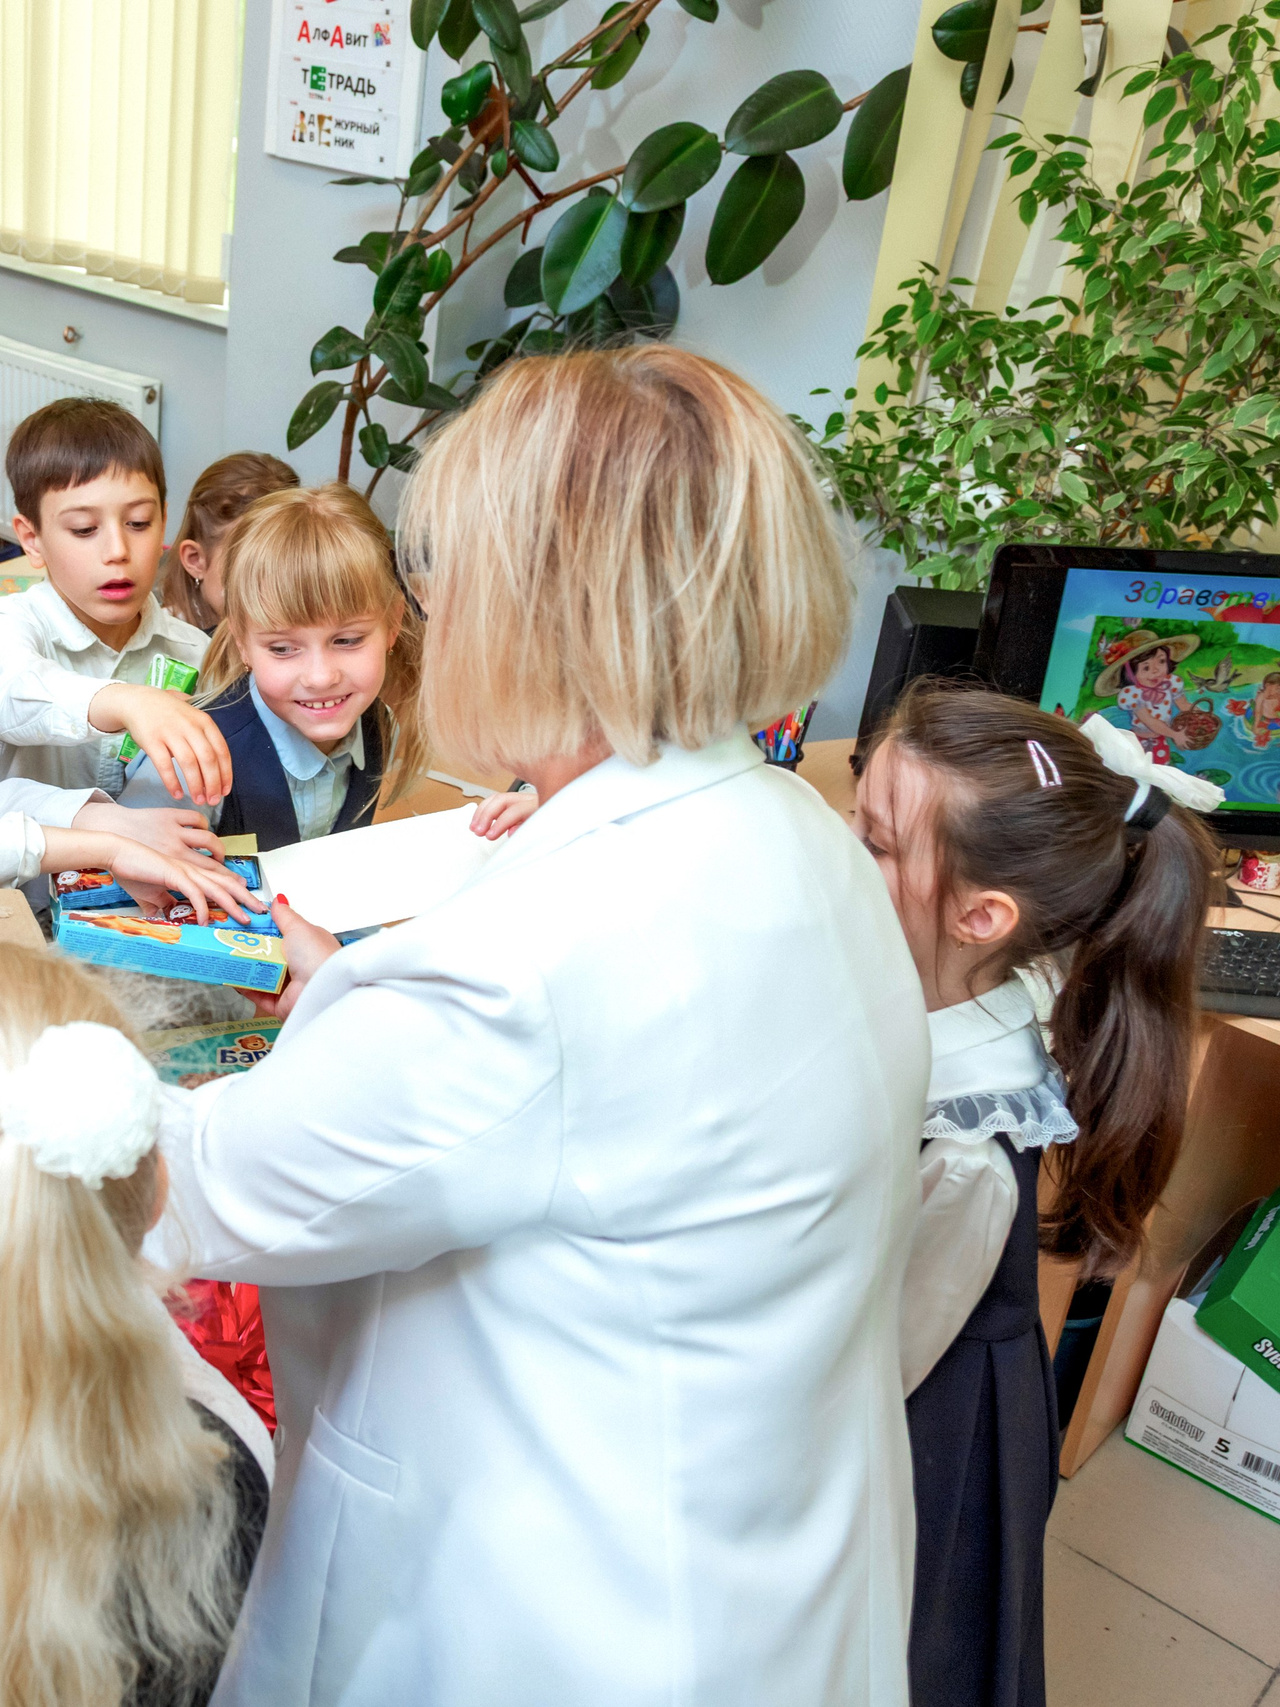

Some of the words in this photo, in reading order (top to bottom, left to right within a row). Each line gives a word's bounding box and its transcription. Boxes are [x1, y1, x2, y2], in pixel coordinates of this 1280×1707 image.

[301, 65, 377, 97] ТЕТРАДЬ
[221, 1049, 271, 1064] Бар
[1253, 1338, 1280, 1370] Sve
[1149, 1399, 1205, 1442] SvetoCopy
[1214, 1437, 1231, 1453] 5
